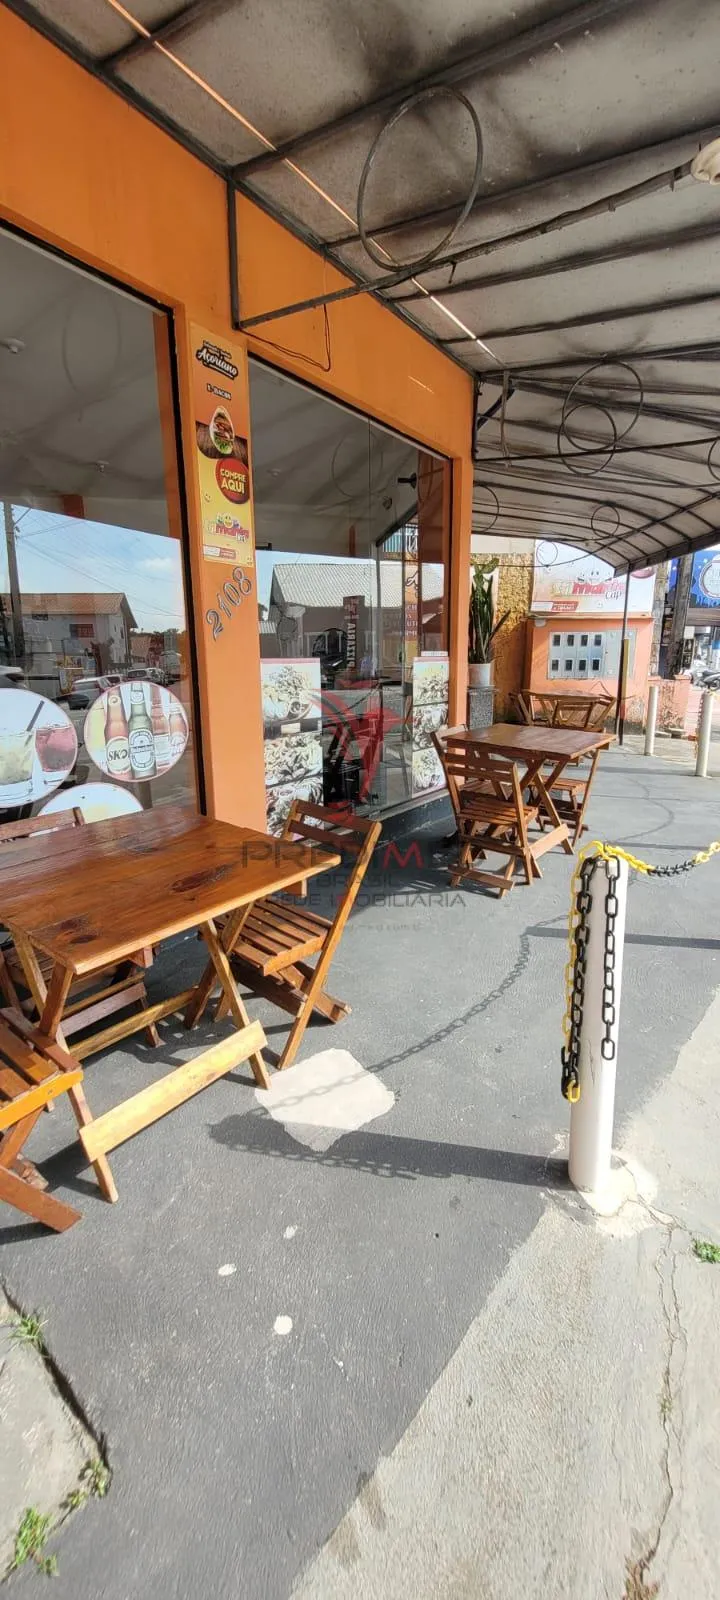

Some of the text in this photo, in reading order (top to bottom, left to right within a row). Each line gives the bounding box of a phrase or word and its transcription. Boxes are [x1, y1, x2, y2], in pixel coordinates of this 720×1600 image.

[220, 469, 246, 482] COMPRE
[221, 478, 245, 494] AQUI
[206, 567, 251, 641] 2108
